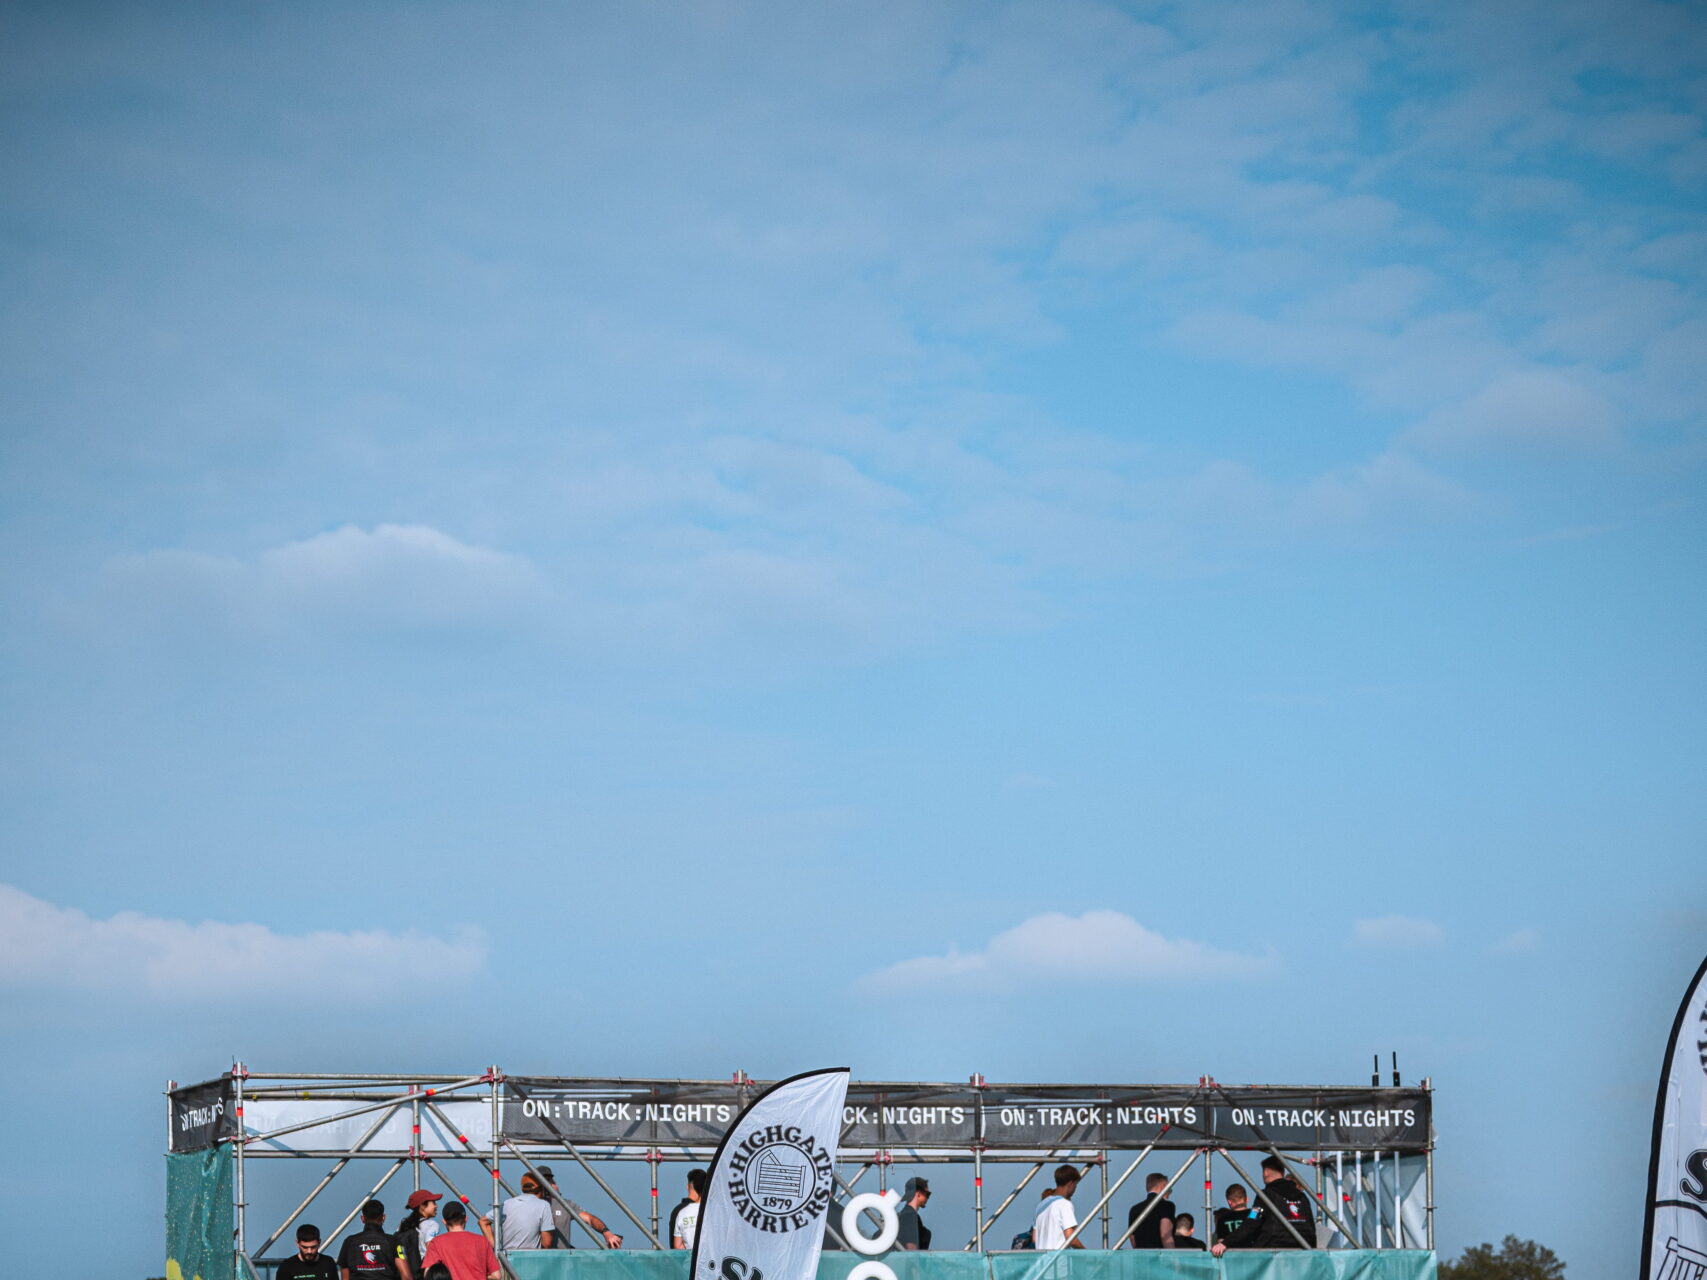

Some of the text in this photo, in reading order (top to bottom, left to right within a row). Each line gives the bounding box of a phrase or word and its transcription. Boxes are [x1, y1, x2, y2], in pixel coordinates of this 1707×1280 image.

[522, 1099, 731, 1122] ON:TRACK:NIGHTS
[842, 1106, 965, 1125] CK:NIGHTS
[1000, 1107, 1197, 1125] ON:TRACK:NIGHTS
[1231, 1108, 1416, 1127] ON:TRACK:NIGHTS
[729, 1125, 833, 1181] HIGHGATE
[728, 1178, 830, 1233] HARRIERS
[762, 1197, 792, 1210] 1879
